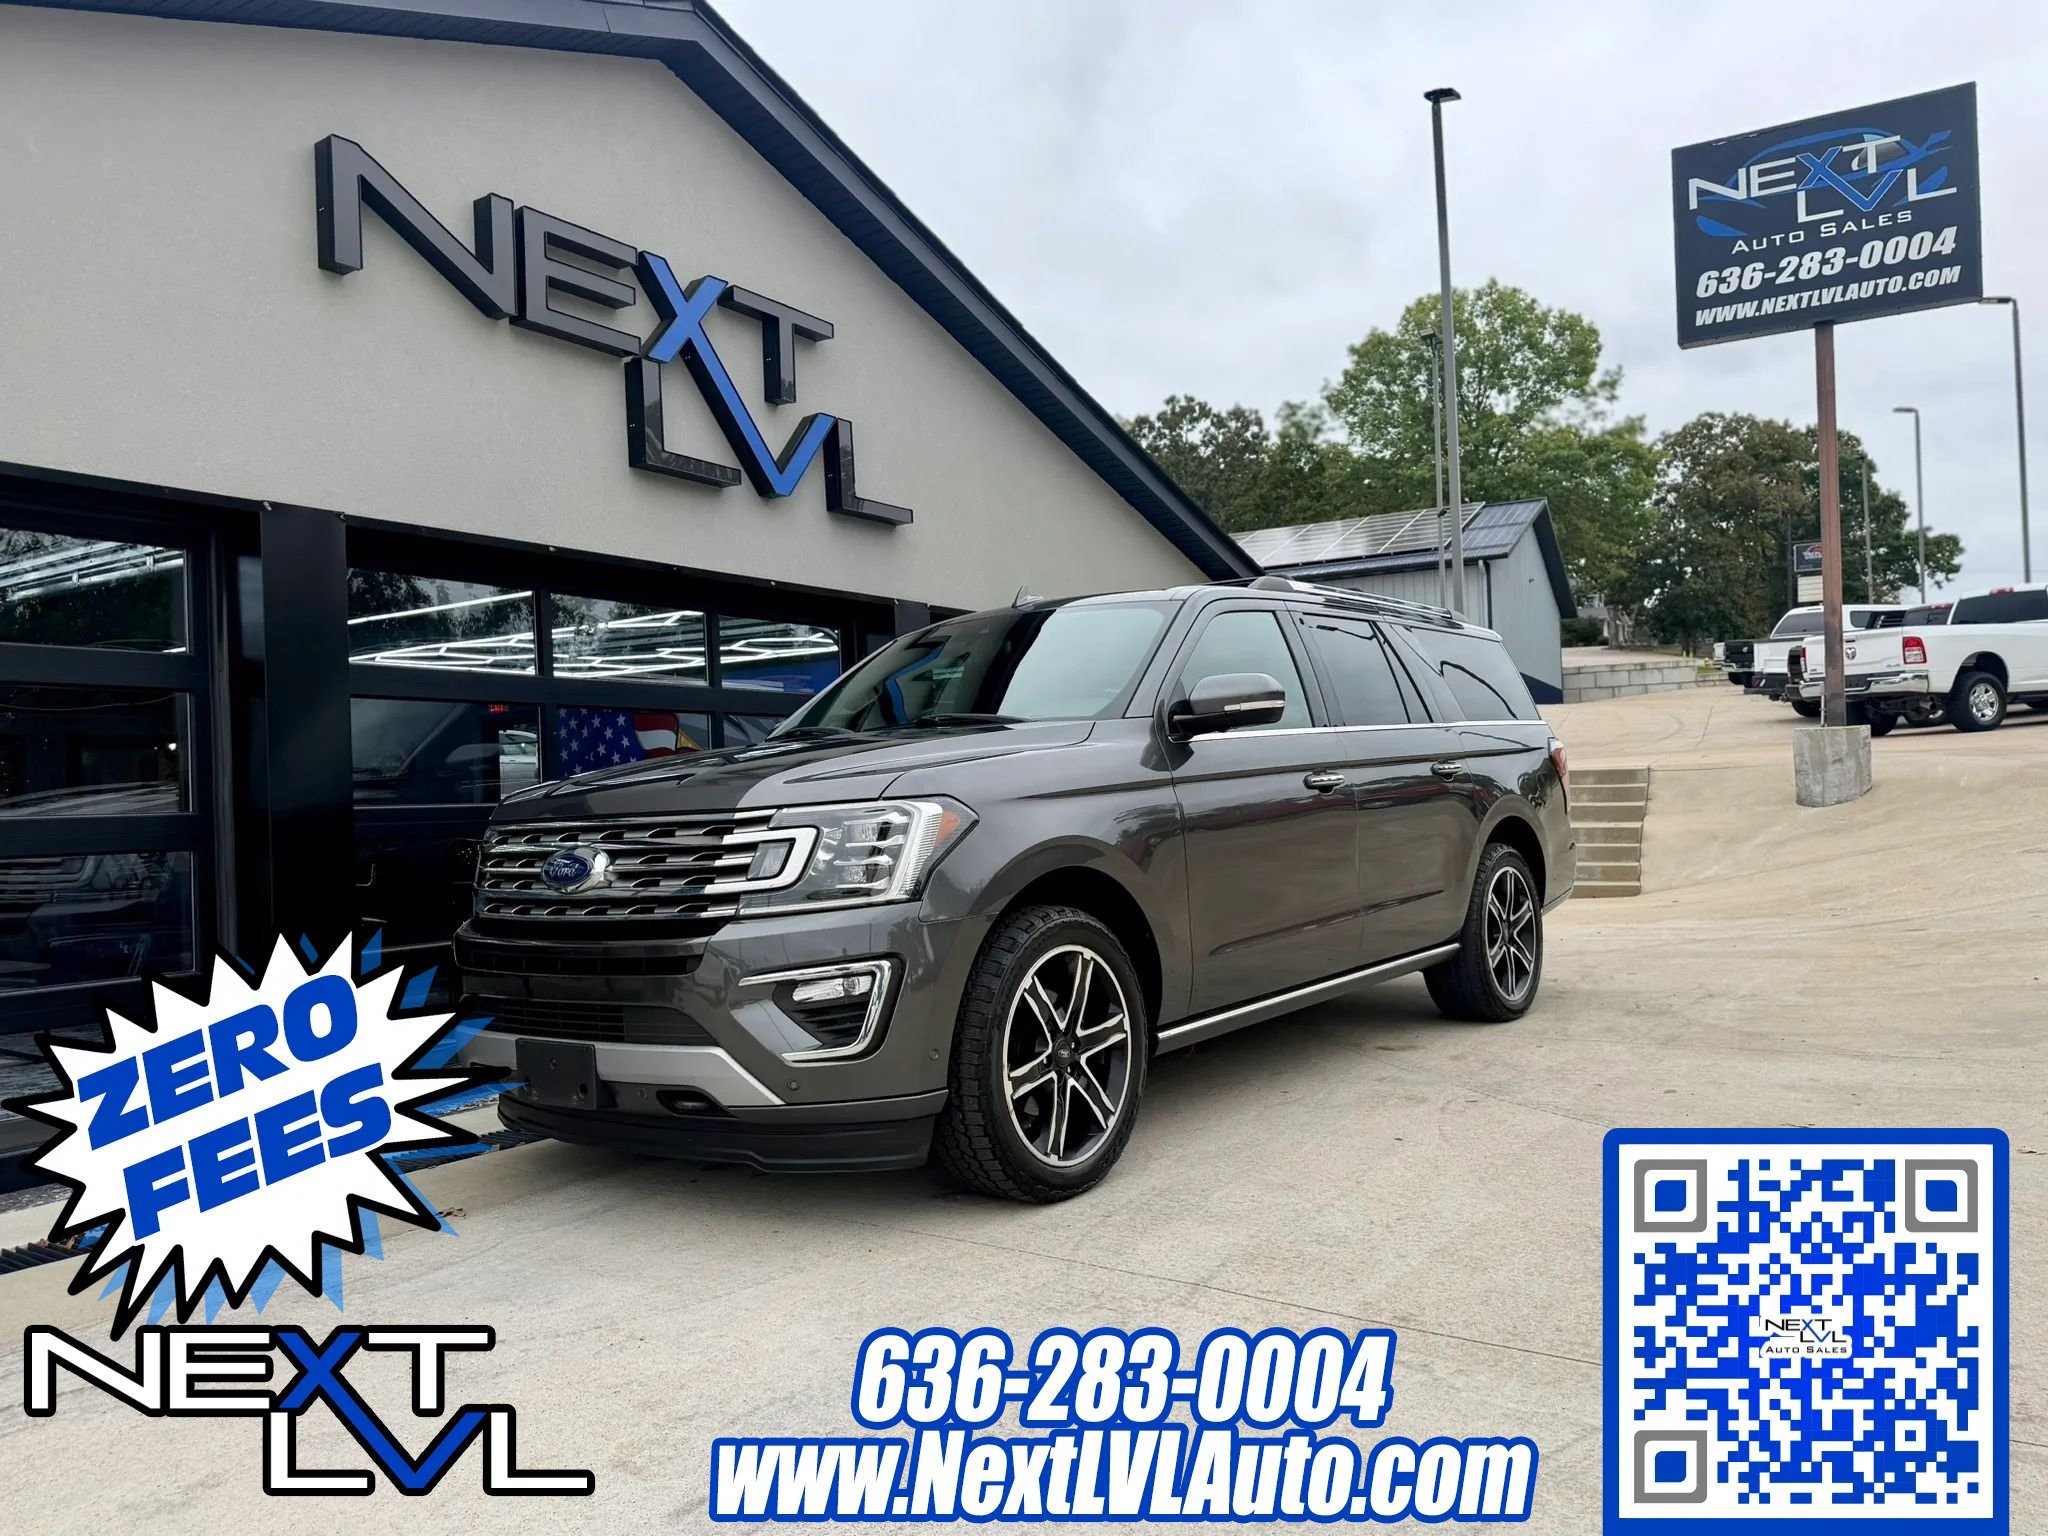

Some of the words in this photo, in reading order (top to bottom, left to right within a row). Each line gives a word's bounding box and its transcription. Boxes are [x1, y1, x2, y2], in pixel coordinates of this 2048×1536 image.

[1688, 135, 1901, 211] NEXT
[1797, 166, 1957, 224] LVL
[1695, 226, 1959, 298] 636-283-0004
[1731, 229, 1804, 255] AUTO
[1820, 210, 1912, 239] SALES
[314, 133, 834, 406] NEXT
[1695, 265, 1961, 327] WWW.NEXTLVLAUTO.COM
[624, 357, 914, 526] LVL
[550, 858, 579, 878] Ford
